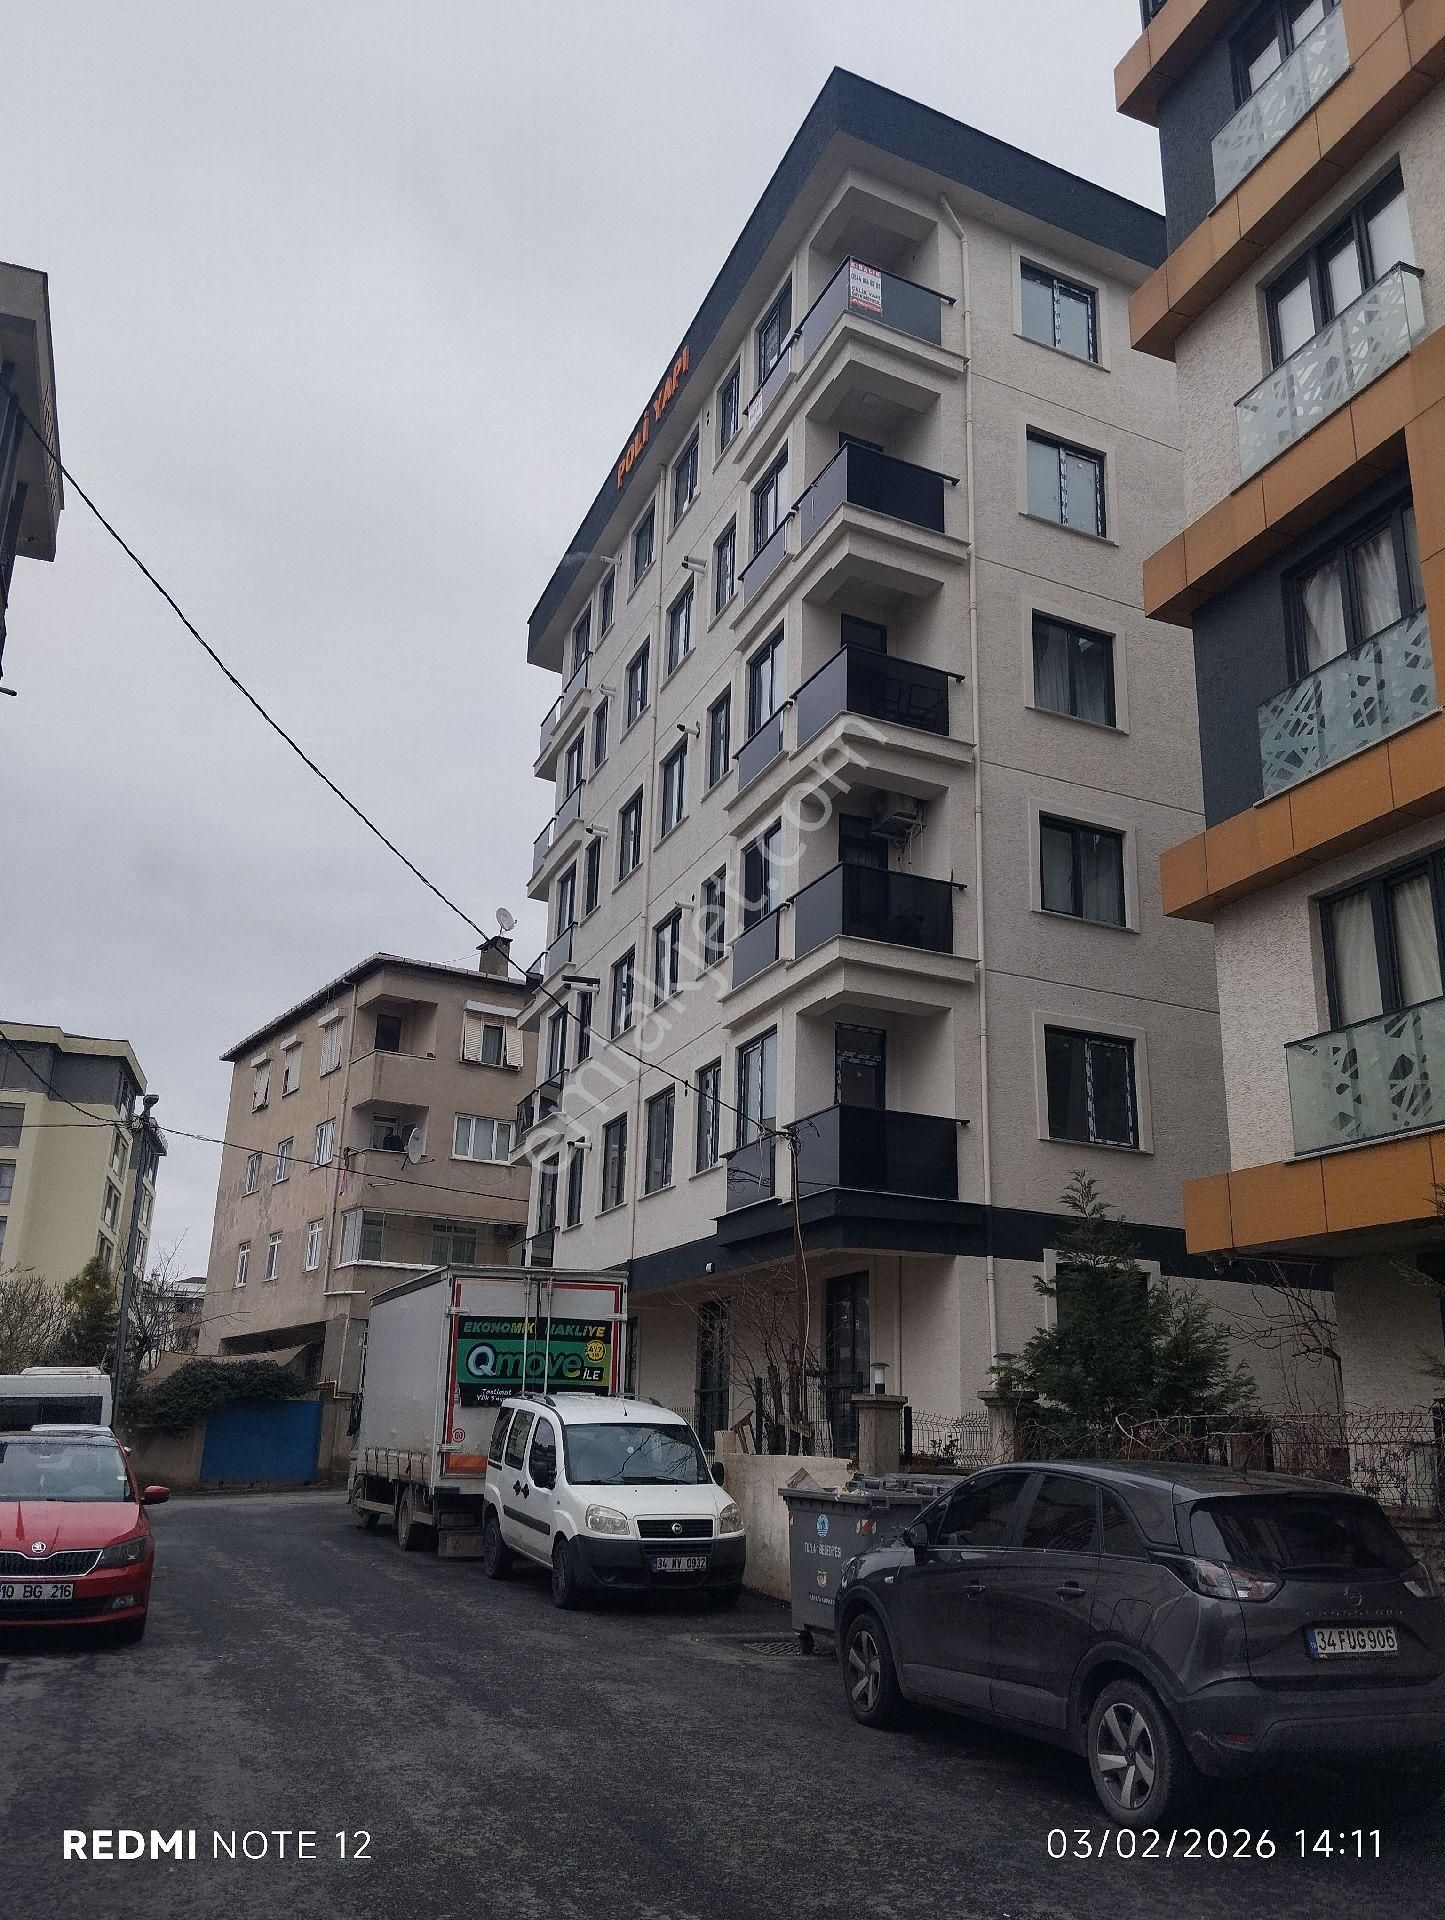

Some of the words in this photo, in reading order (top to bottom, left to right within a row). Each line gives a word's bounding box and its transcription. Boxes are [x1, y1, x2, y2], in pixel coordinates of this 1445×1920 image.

[657, 1558, 668, 1569] 34
[1, 1584, 15, 1599] 10
[22, 1584, 43, 1599] BG
[50, 1584, 72, 1598] 216
[1317, 1631, 1336, 1651] 34
[1338, 1630, 1366, 1650] FUG
[1367, 1629, 1396, 1649] 906
